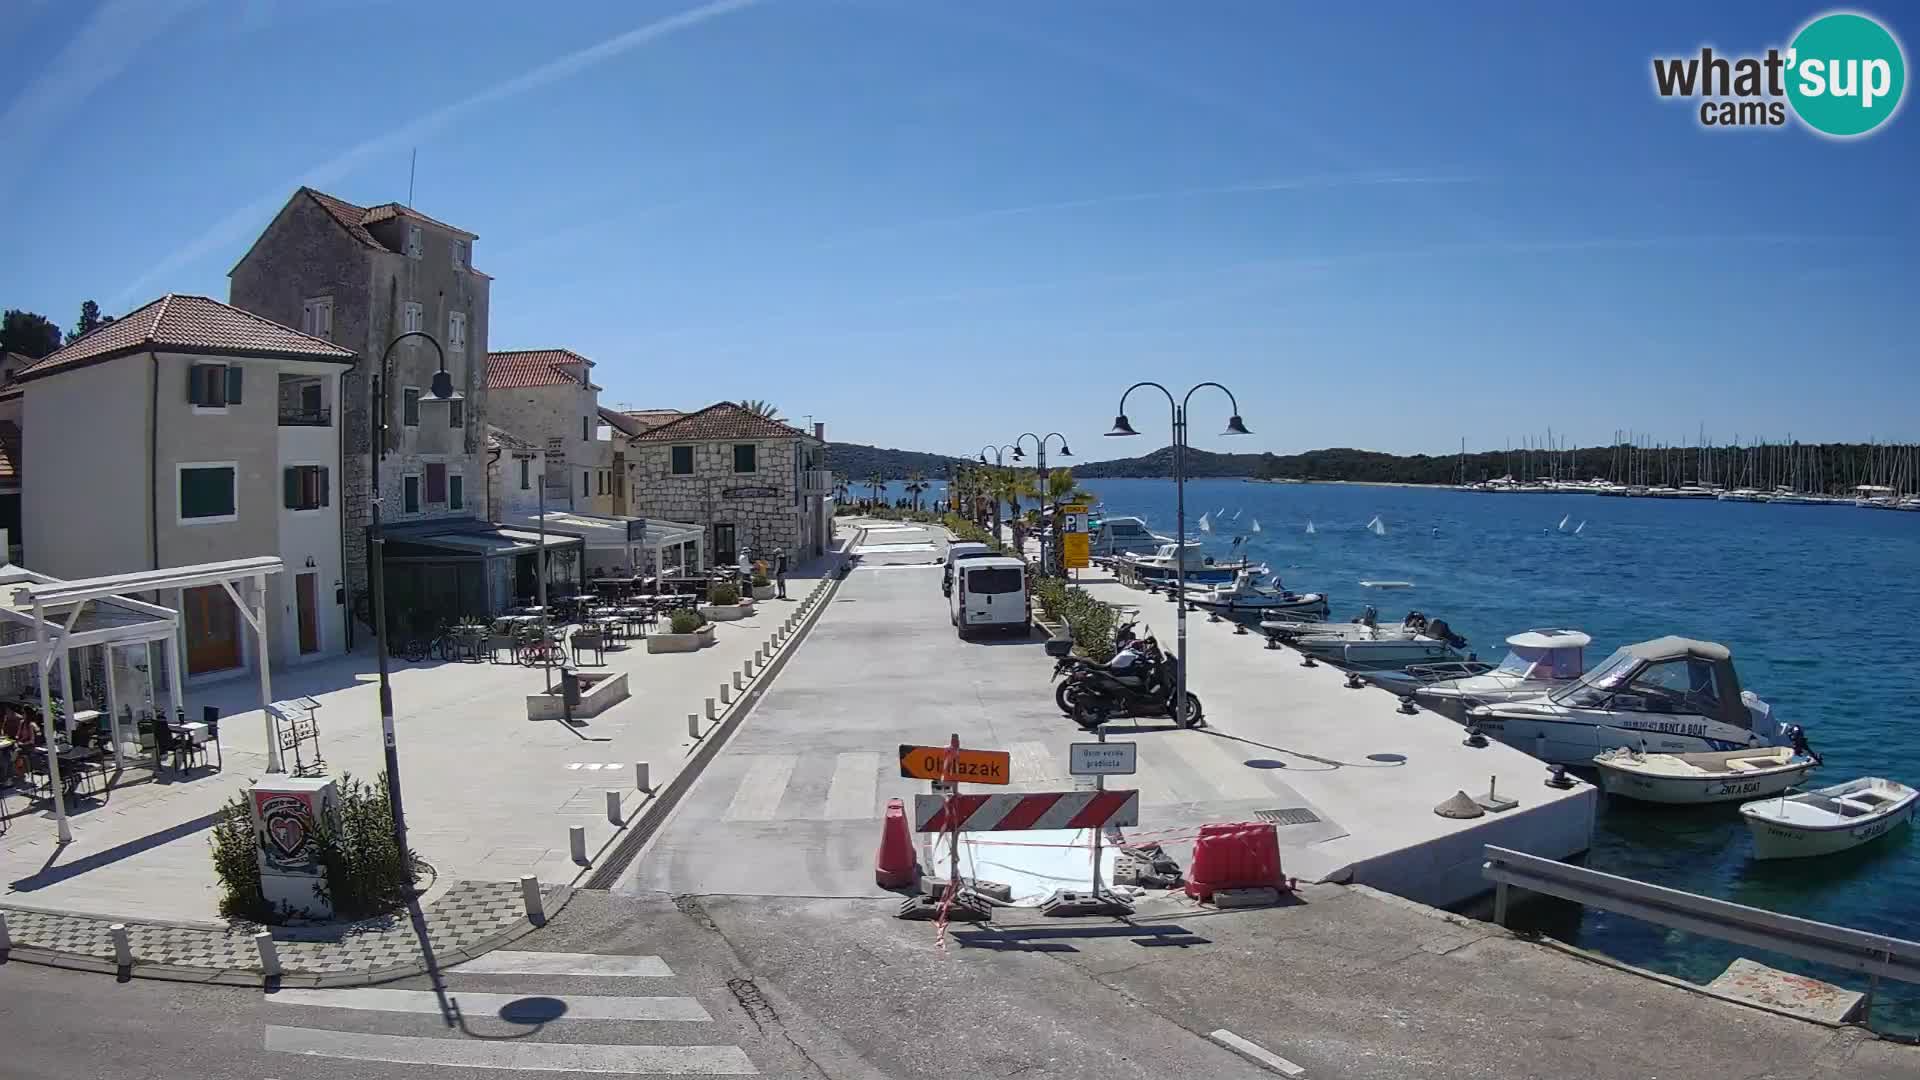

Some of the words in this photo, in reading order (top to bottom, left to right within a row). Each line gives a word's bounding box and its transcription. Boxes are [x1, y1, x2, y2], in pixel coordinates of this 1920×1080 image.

[1658, 722, 1681, 733] RENT
[1680, 723, 1686, 734] A
[1687, 724, 1709, 737] BOAT
